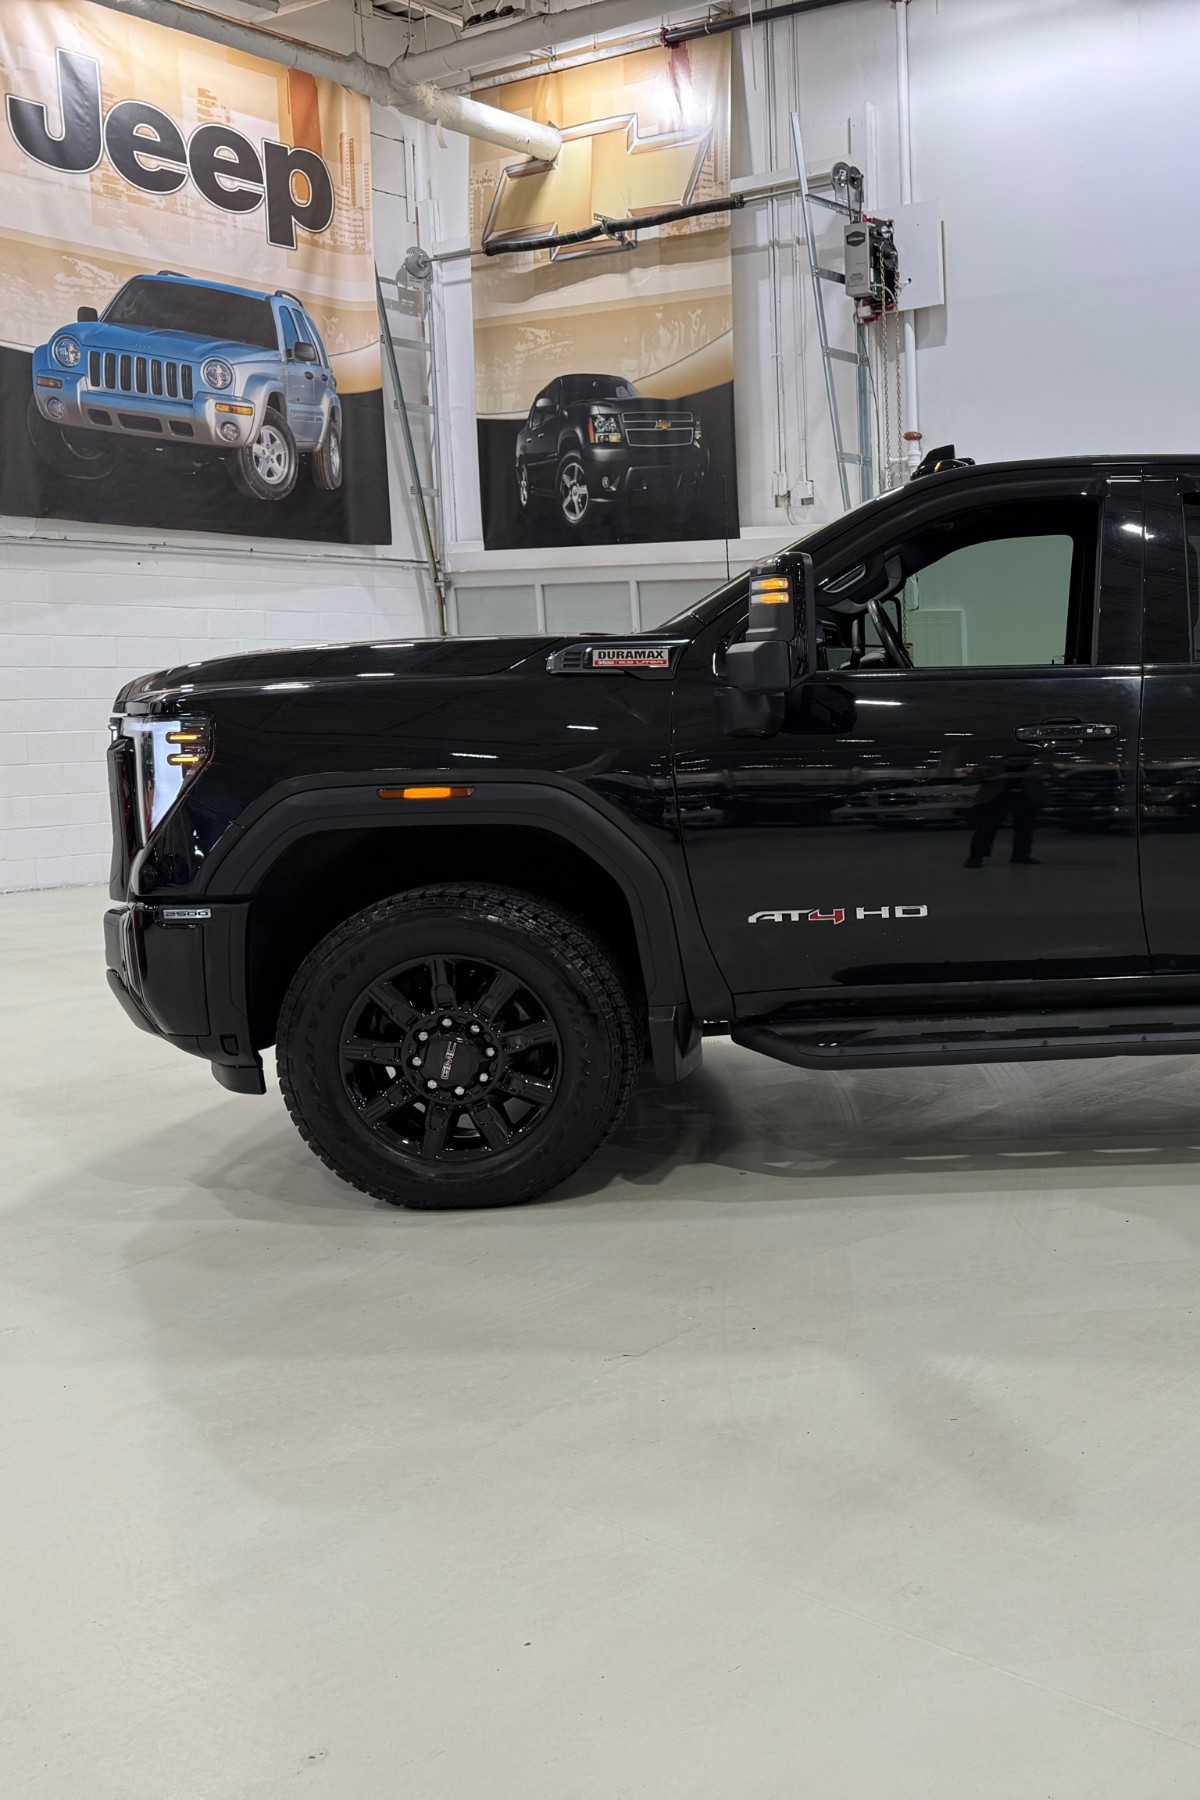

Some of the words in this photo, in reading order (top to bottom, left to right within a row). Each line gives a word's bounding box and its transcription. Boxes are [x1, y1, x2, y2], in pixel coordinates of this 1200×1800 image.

[6, 47, 334, 249] Jeep
[597, 650, 664, 660] DURAMAX
[165, 909, 210, 918] 2500
[748, 908, 845, 925] AT4
[856, 904, 928, 920] HD
[440, 1041, 457, 1080] GMC
